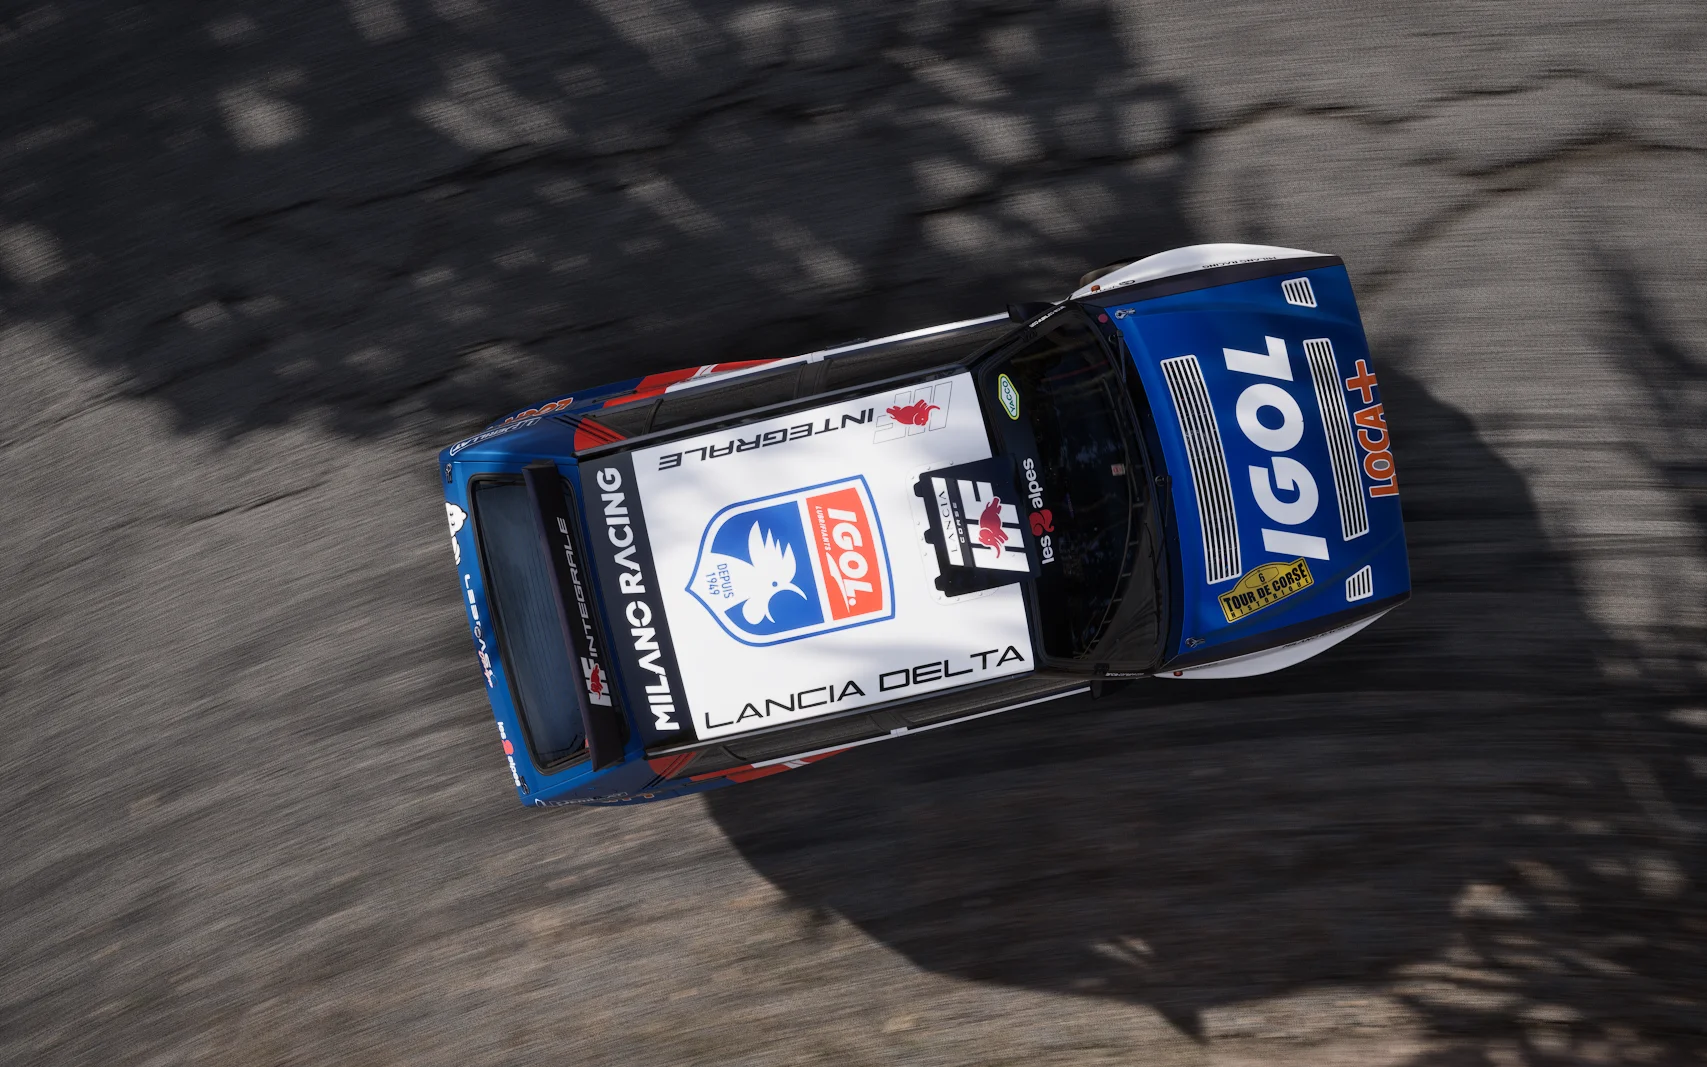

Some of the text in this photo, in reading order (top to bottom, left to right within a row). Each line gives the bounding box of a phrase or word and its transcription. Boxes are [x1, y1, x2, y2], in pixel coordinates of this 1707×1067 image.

[1002, 380, 1016, 412] YACCO
[658, 407, 875, 471] INTEGRALE
[1222, 335, 1330, 561] IGOL
[1023, 458, 1044, 509] alpes
[596, 466, 646, 595] RACING
[815, 505, 832, 552] LUBRIFIANTS
[938, 490, 958, 553] LANCIA
[1040, 535, 1055, 565] les
[555, 516, 598, 658] INTEGRALE
[706, 572, 721, 596] 1949
[717, 563, 735, 599] DEPUIS
[1223, 562, 1307, 613] TOUR DE CORSE
[1231, 577, 1309, 619] HISTORIQUE
[1258, 572, 1266, 583] 6
[626, 600, 680, 731] MILANO
[704, 645, 1025, 729] LANCIA DELTA
